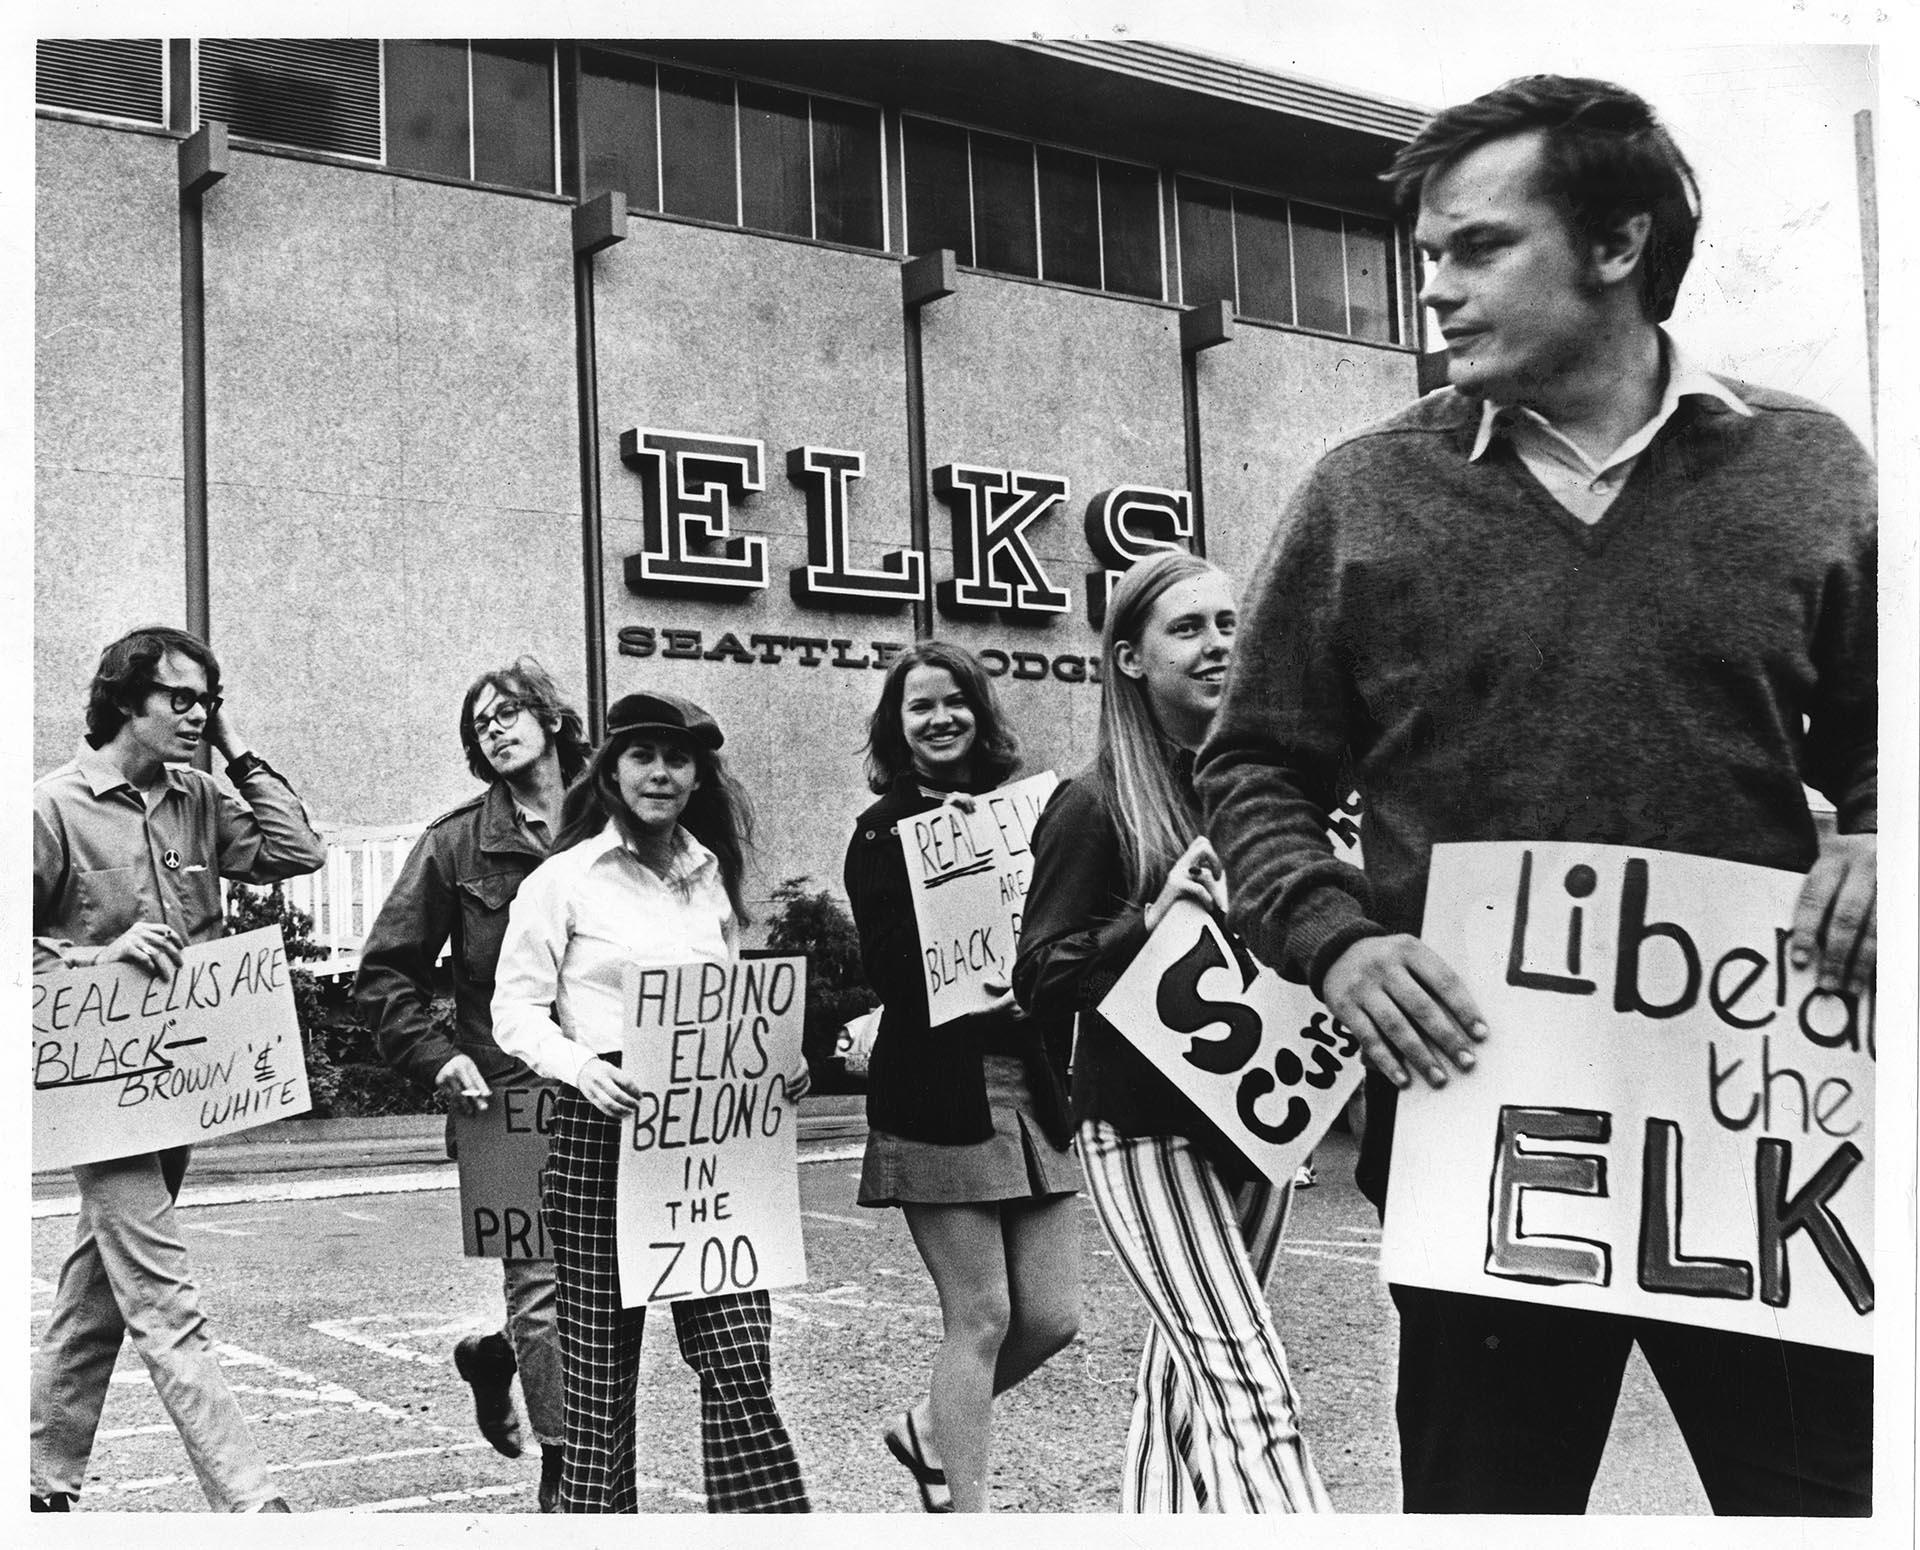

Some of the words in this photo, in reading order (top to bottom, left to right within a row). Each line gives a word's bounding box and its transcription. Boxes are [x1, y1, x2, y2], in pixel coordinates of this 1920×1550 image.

[620, 427, 1193, 632] ELKS
[618, 626, 902, 670] SEATTLE
[978, 648, 1103, 683] ODG
[914, 811, 994, 878] REAL
[1000, 869, 1029, 906] ARE
[32, 977, 130, 1033] REAL
[141, 961, 222, 1018] ELKS
[231, 947, 285, 997] ARE
[636, 961, 796, 1028] ALBINO
[118, 1051, 237, 1107] BROWN
[670, 1016, 770, 1083] ELKS
[200, 1078, 297, 1129] WHITE
[633, 1073, 787, 1152] BELONG
[1708, 1034, 1863, 1137] the
[684, 1153, 717, 1191] IN
[665, 1192, 733, 1230] THE
[1484, 1103, 1875, 1316] ELK
[647, 1234, 759, 1303] ZOO
